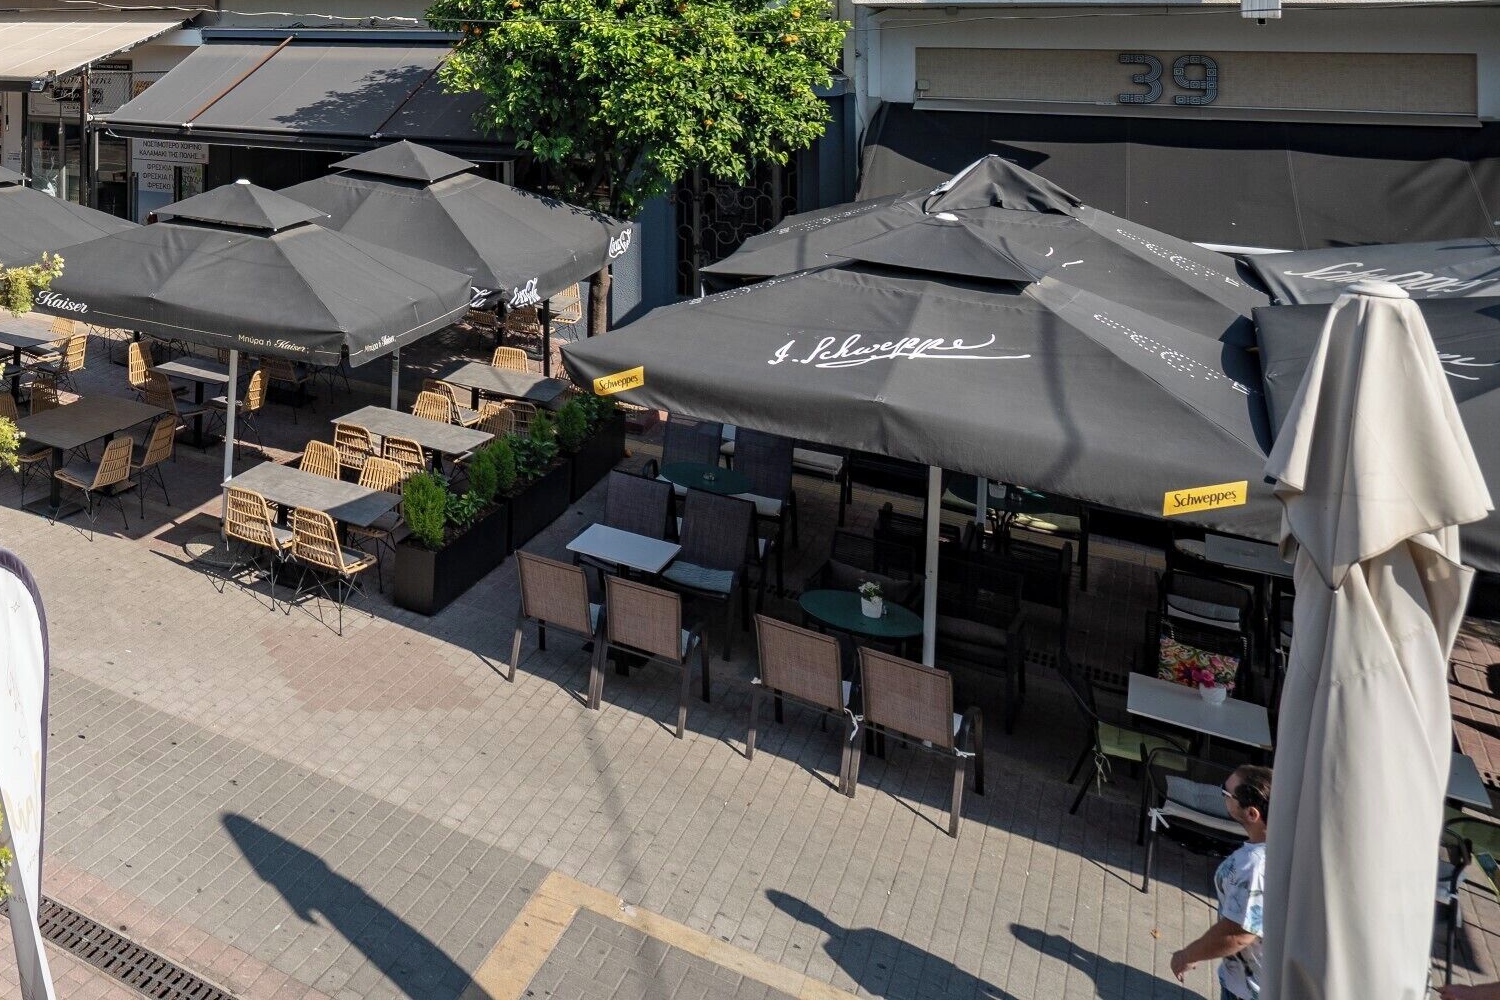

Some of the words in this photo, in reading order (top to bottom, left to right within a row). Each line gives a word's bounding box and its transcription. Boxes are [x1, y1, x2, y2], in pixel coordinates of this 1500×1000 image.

[1119, 53, 1218, 105] 39
[35, 290, 88, 313] Kaiser
[238, 334, 264, 346] Μπύρα
[599, 374, 639, 391] Schweppes
[1173, 490, 1236, 508] Schweppes
